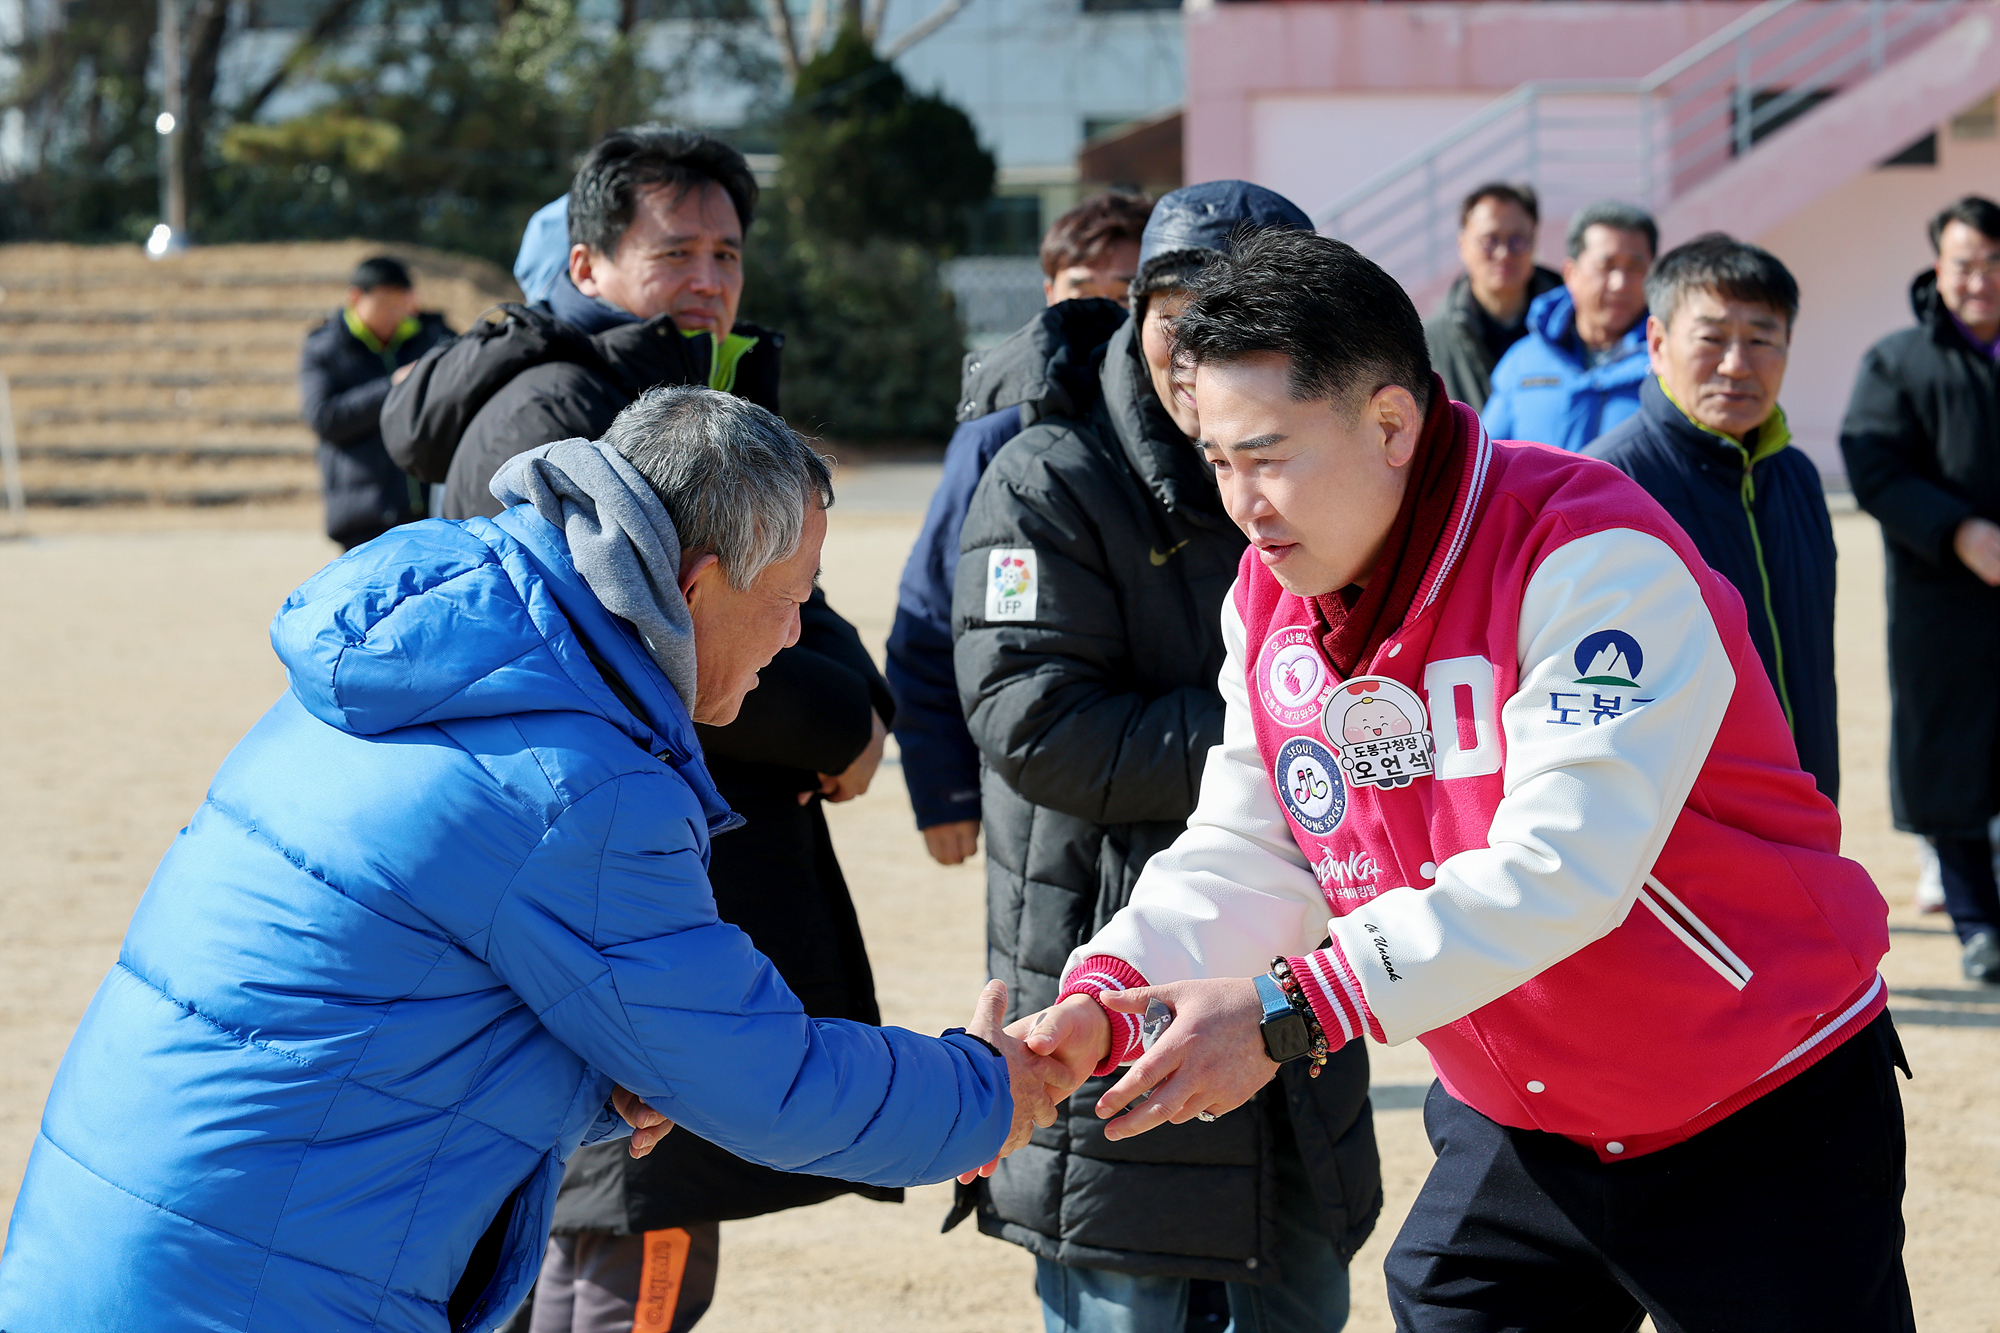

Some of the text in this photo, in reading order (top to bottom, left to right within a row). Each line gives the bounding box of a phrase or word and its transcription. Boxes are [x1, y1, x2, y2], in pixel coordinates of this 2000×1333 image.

[997, 601, 1022, 615] LFP
[1423, 655, 1502, 781] D
[1546, 692, 1657, 726] 도봉
[1286, 743, 1314, 760] SEOUL
[1353, 736, 1418, 759] 도봉구청장
[1289, 798, 1343, 832] DOBONG SOCKS
[1333, 883, 1378, 900] 브레이킹팀
[1374, 935, 1403, 983] Unseok
[644, 1240, 674, 1326] umbro
